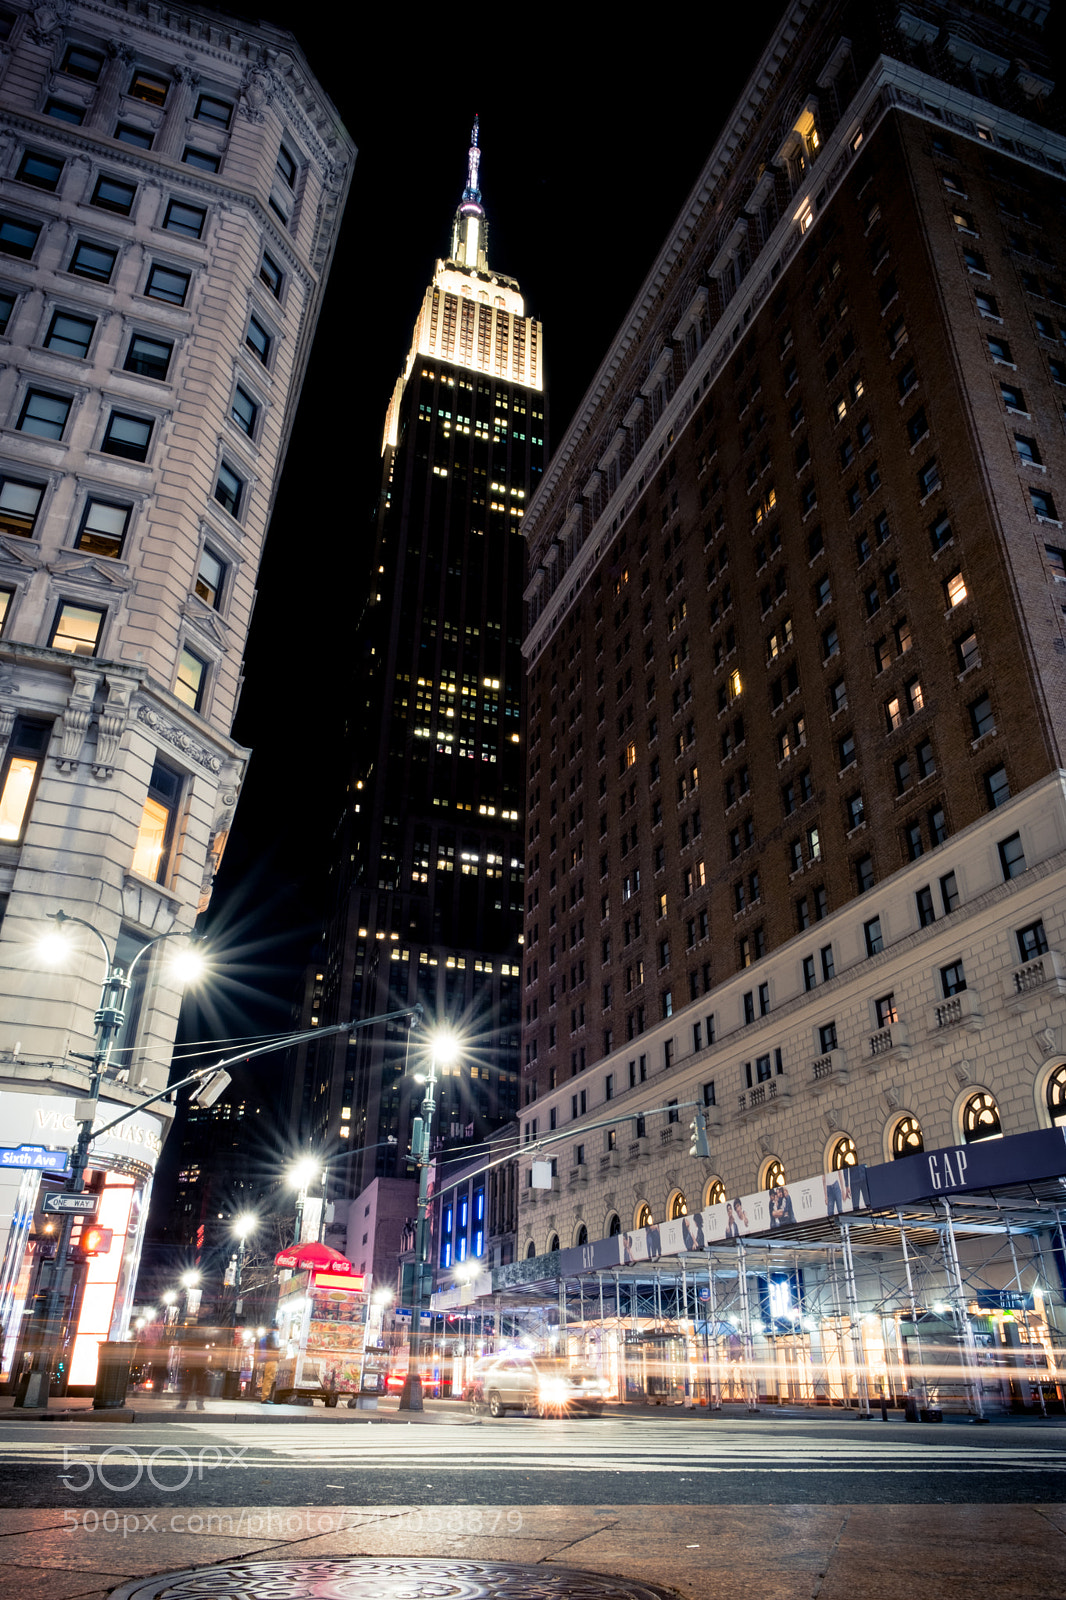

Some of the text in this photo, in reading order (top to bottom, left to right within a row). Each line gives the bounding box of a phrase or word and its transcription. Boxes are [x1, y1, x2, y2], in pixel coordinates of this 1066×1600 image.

[2, 1152, 56, 1166] Sixth Ave
[928, 1150, 967, 1189] GAP
[74, 1199, 90, 1207] WAY
